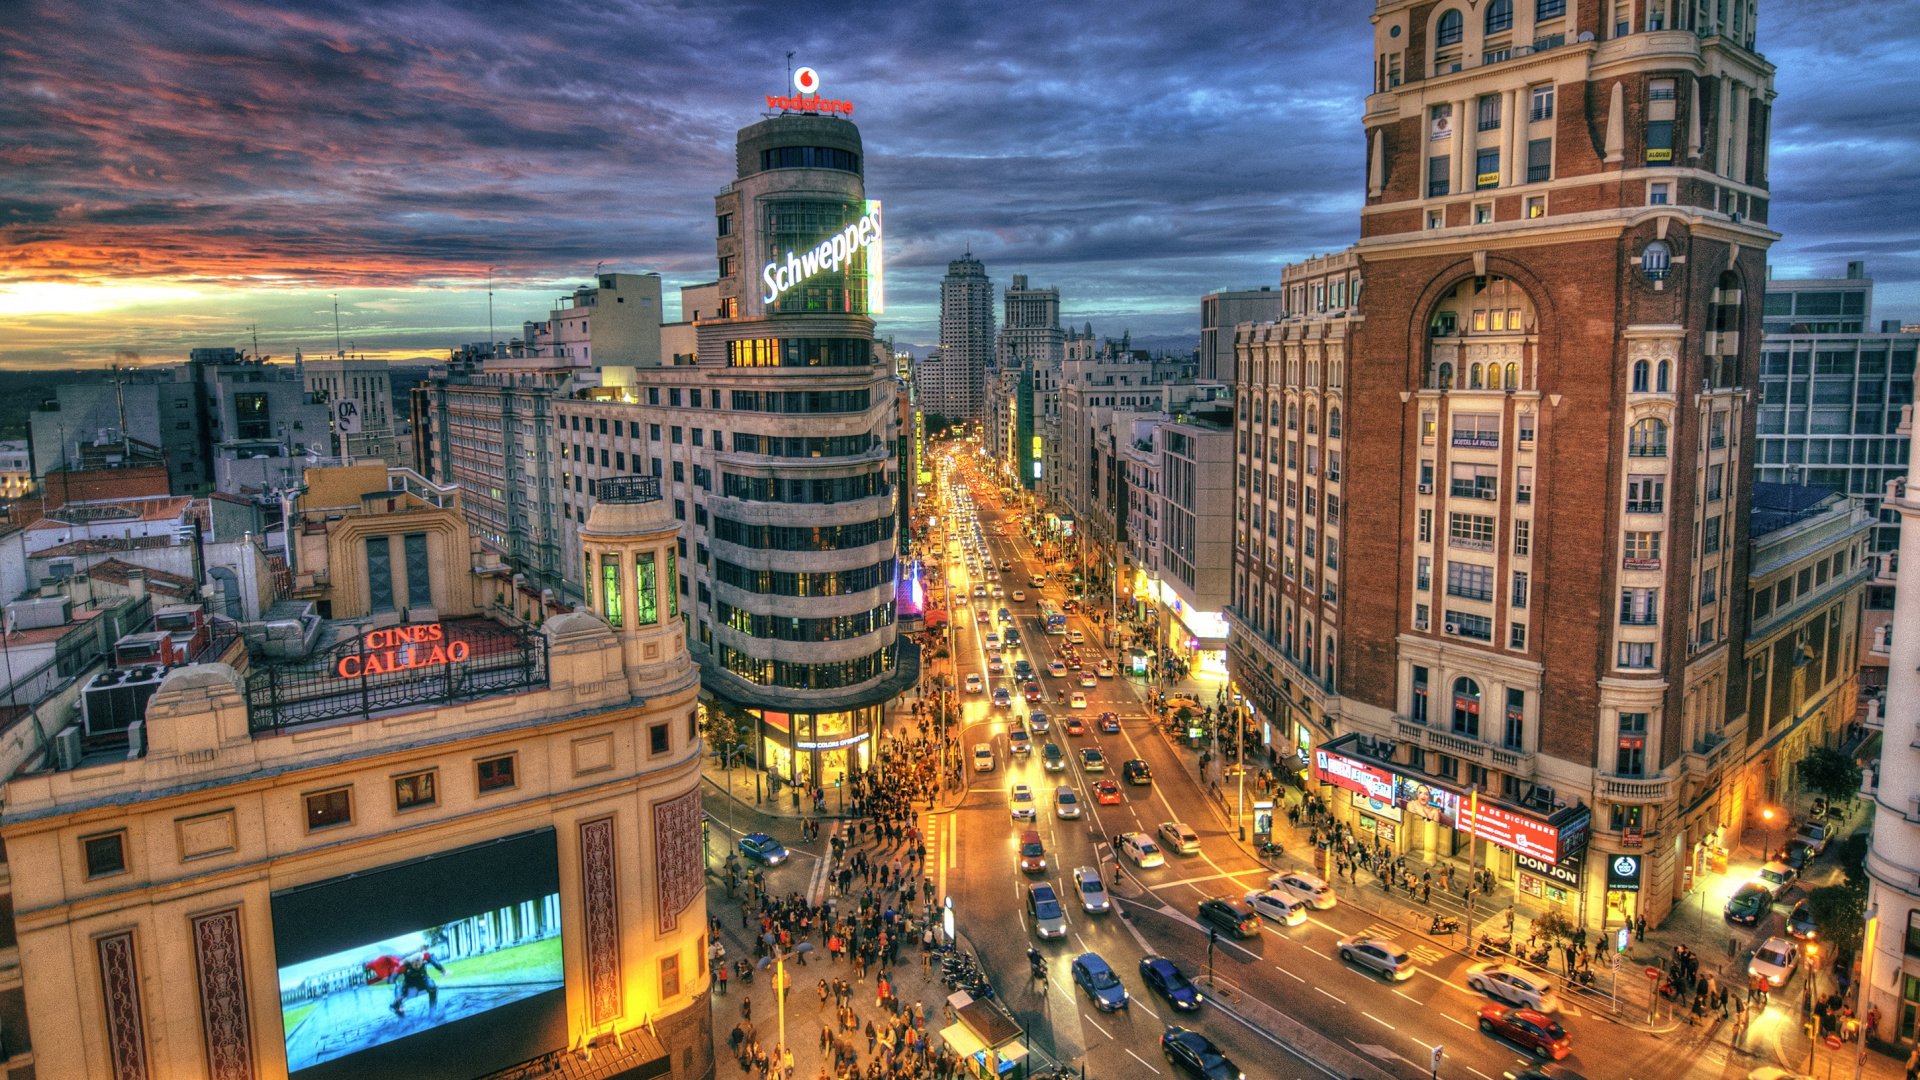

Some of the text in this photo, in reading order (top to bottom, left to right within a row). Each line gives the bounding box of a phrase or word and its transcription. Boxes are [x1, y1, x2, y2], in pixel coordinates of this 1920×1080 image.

[766, 94, 853, 114] vodafone
[763, 207, 881, 304] Schweppes
[365, 622, 443, 650] CINES
[338, 641, 470, 679] CALLAO
[1489, 809, 1501, 817] DE
[1505, 813, 1555, 836] DICIEMBRE
[1518, 854, 1548, 873] DON
[1549, 867, 1577, 884] JON
[1406, 945, 1445, 966] BUS
